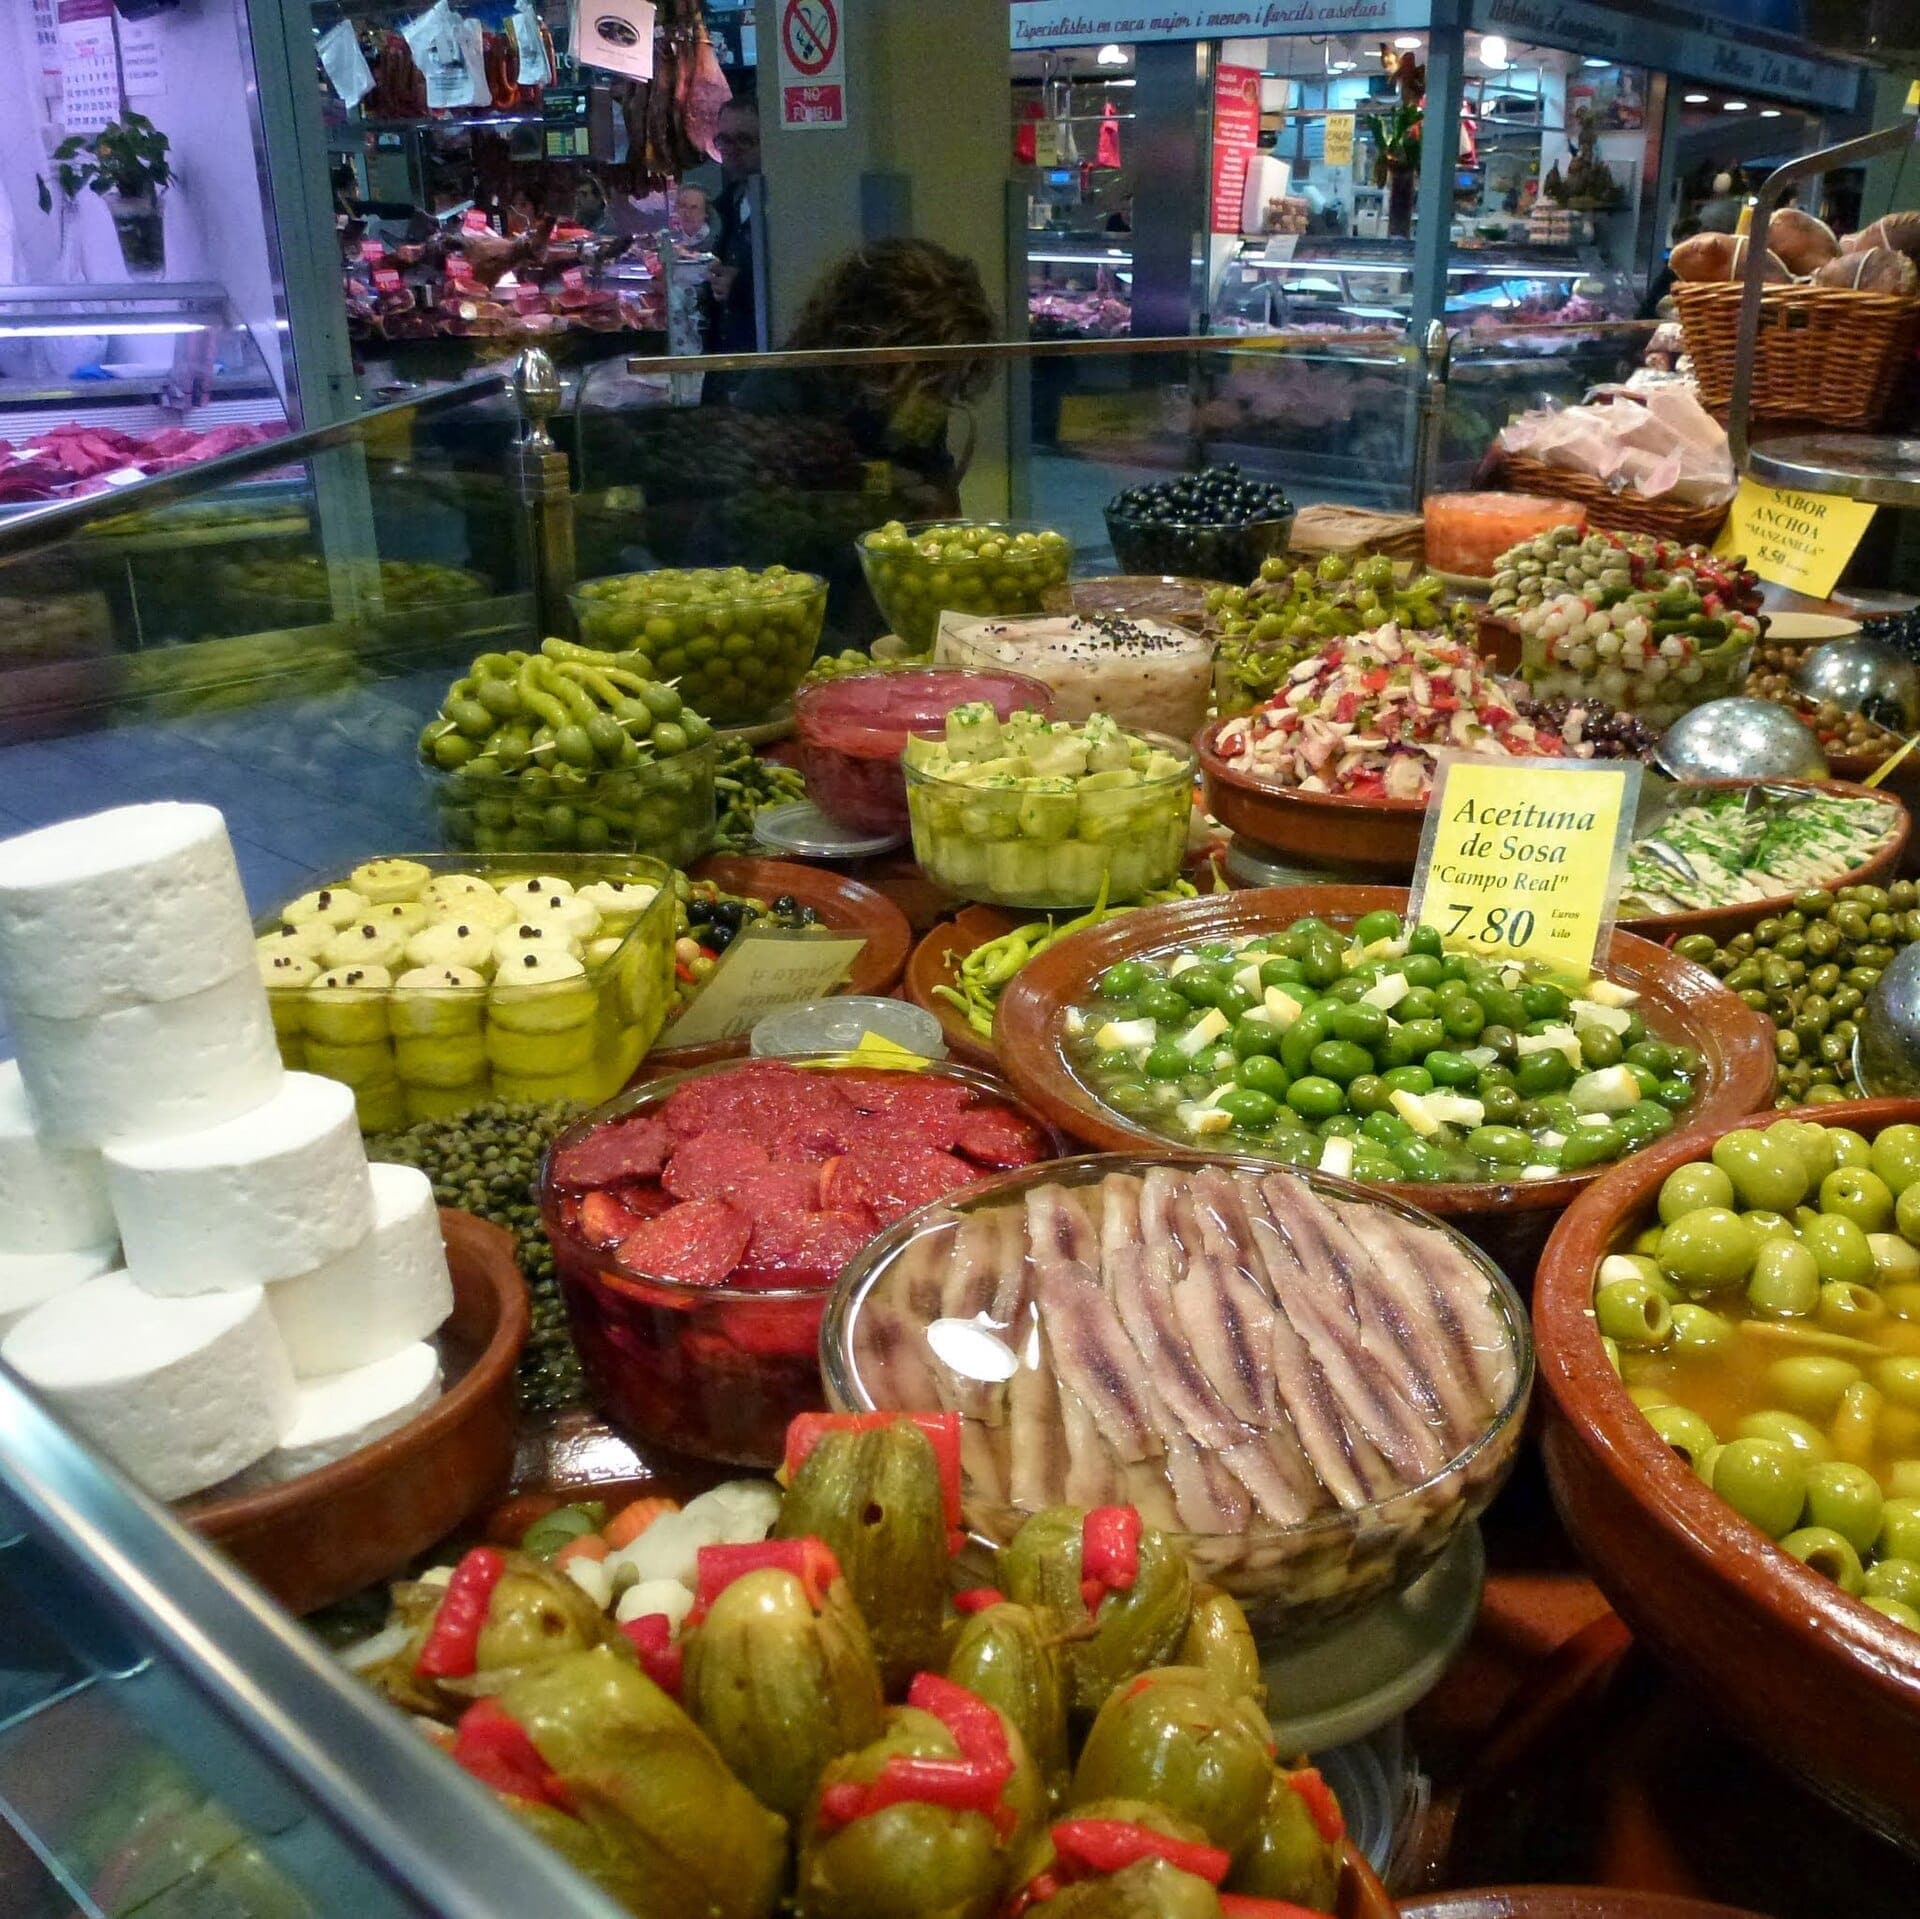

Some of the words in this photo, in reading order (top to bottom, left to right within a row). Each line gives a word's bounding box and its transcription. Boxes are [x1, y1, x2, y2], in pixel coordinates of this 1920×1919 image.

[1097, 20, 1111, 33] en
[1150, 11, 1190, 33] major
[1206, 12, 1250, 27] menor
[1318, 1, 1386, 20] casolans
[803, 87, 821, 101] NO
[1772, 489, 1827, 519] SABOR
[1751, 506, 1819, 540] ANCHOA
[1453, 798, 1596, 831] Aceituna
[1459, 832, 1493, 858] de
[1499, 835, 1567, 864] Sosa
[1432, 864, 1508, 893] "Campo
[1512, 872, 1569, 892] Real"
[1443, 903, 1536, 948] 7.80
[1551, 908, 1580, 920] Euros
[1550, 927, 1571, 939] kilo
